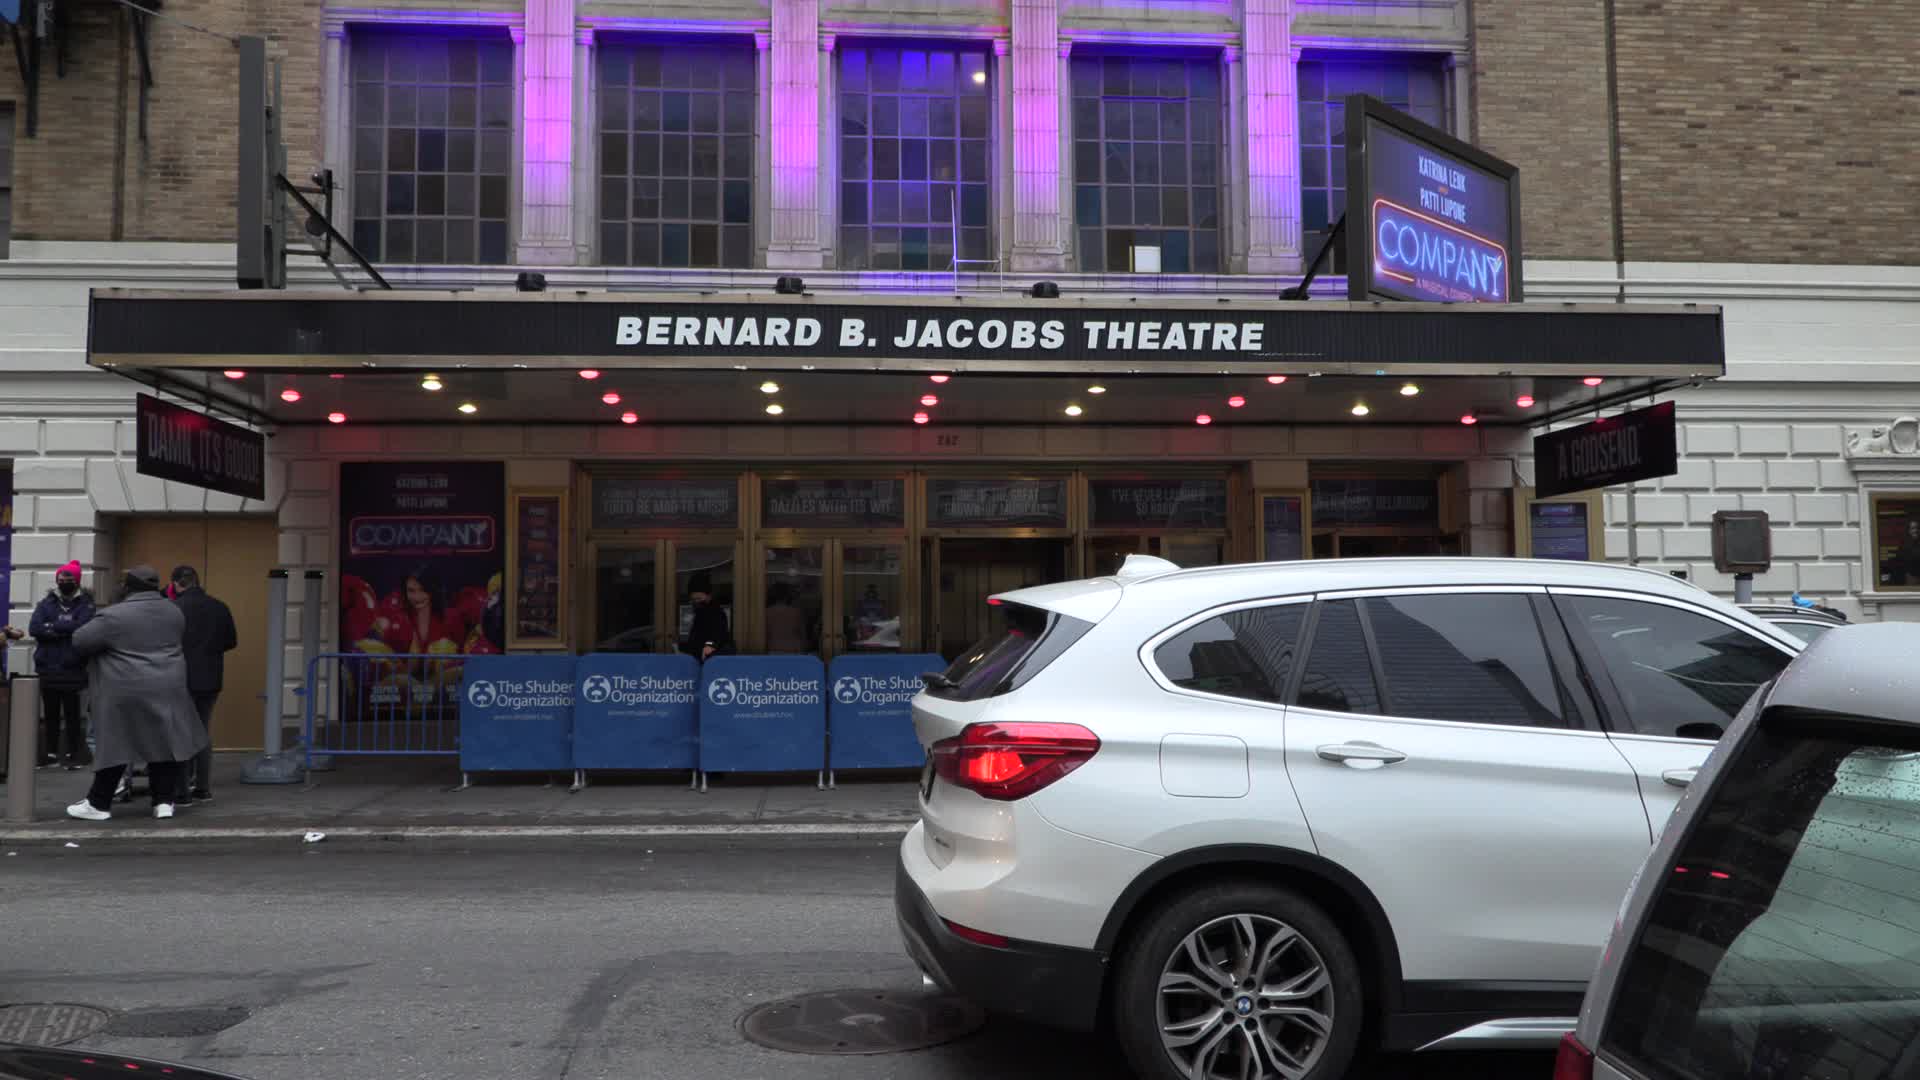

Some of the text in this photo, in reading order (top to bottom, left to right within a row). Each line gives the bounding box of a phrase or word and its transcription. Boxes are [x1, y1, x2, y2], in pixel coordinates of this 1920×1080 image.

[1449, 169, 1466, 193] LENK
[1420, 188, 1439, 213] PATTI
[1379, 219, 1502, 296] COMPANY
[616, 317, 1264, 350] BERNARD B. JACOBS THEATRE
[355, 521, 488, 545] COMPANY
[497, 680, 575, 693] The Shuber
[611, 675, 694, 690] The Shubert
[736, 676, 818, 691] The Shubert
[861, 675, 925, 689] The Shub
[611, 689, 694, 706] Organization
[736, 691, 818, 708] Organization
[861, 689, 912, 706] Organiz
